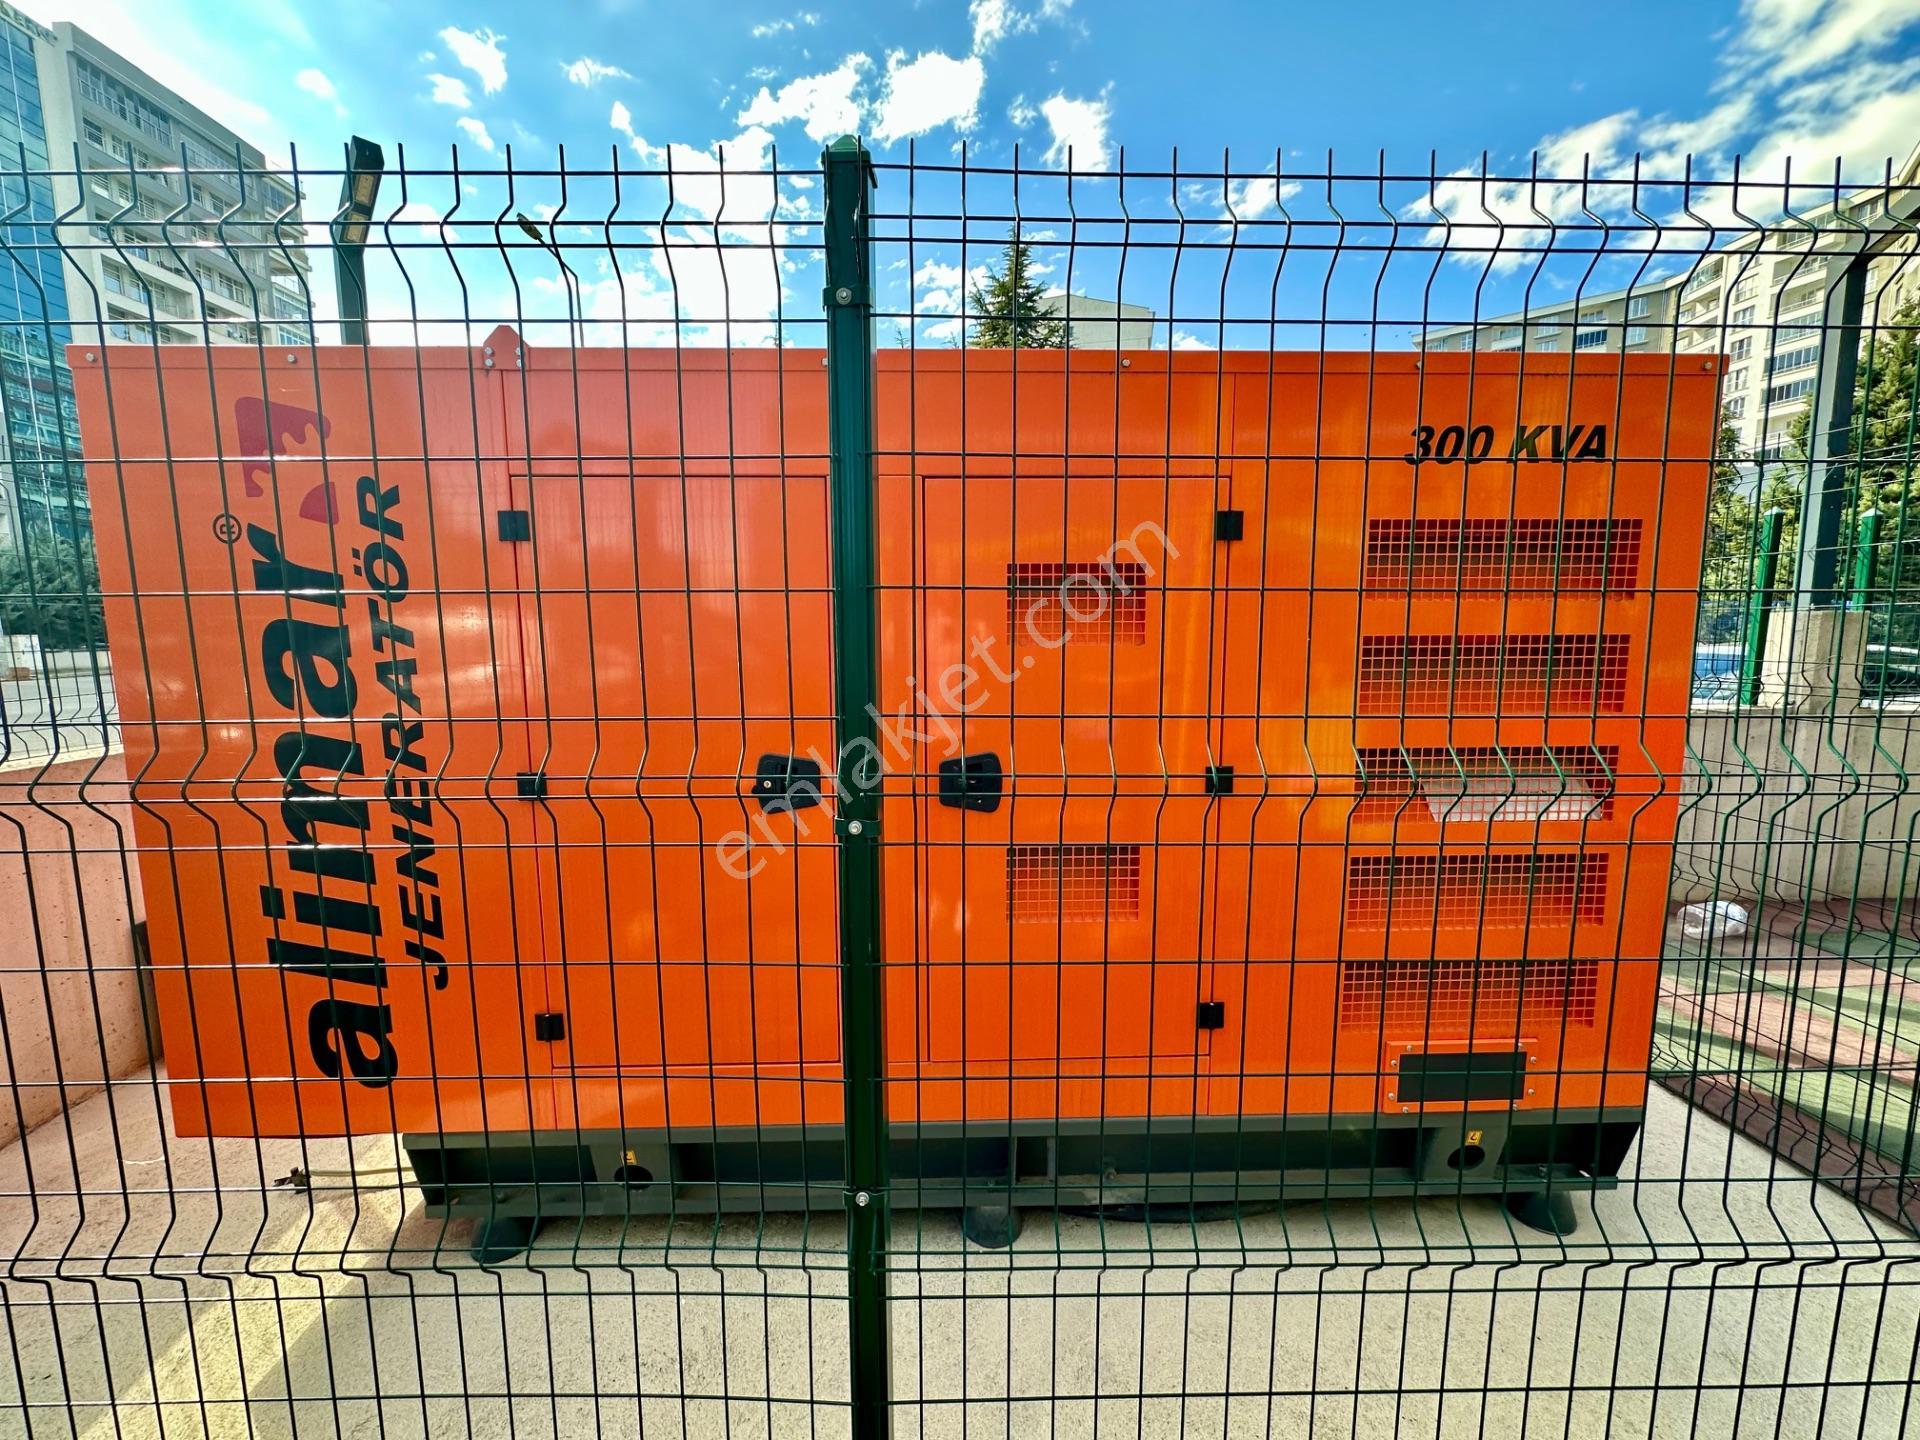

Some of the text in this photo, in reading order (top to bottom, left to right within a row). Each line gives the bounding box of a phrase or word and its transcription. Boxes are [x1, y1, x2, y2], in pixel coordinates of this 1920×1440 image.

[1404, 424, 1607, 466] 300 KVA
[246, 522, 399, 1089] alimar
[352, 475, 449, 991] JENERATÖR
